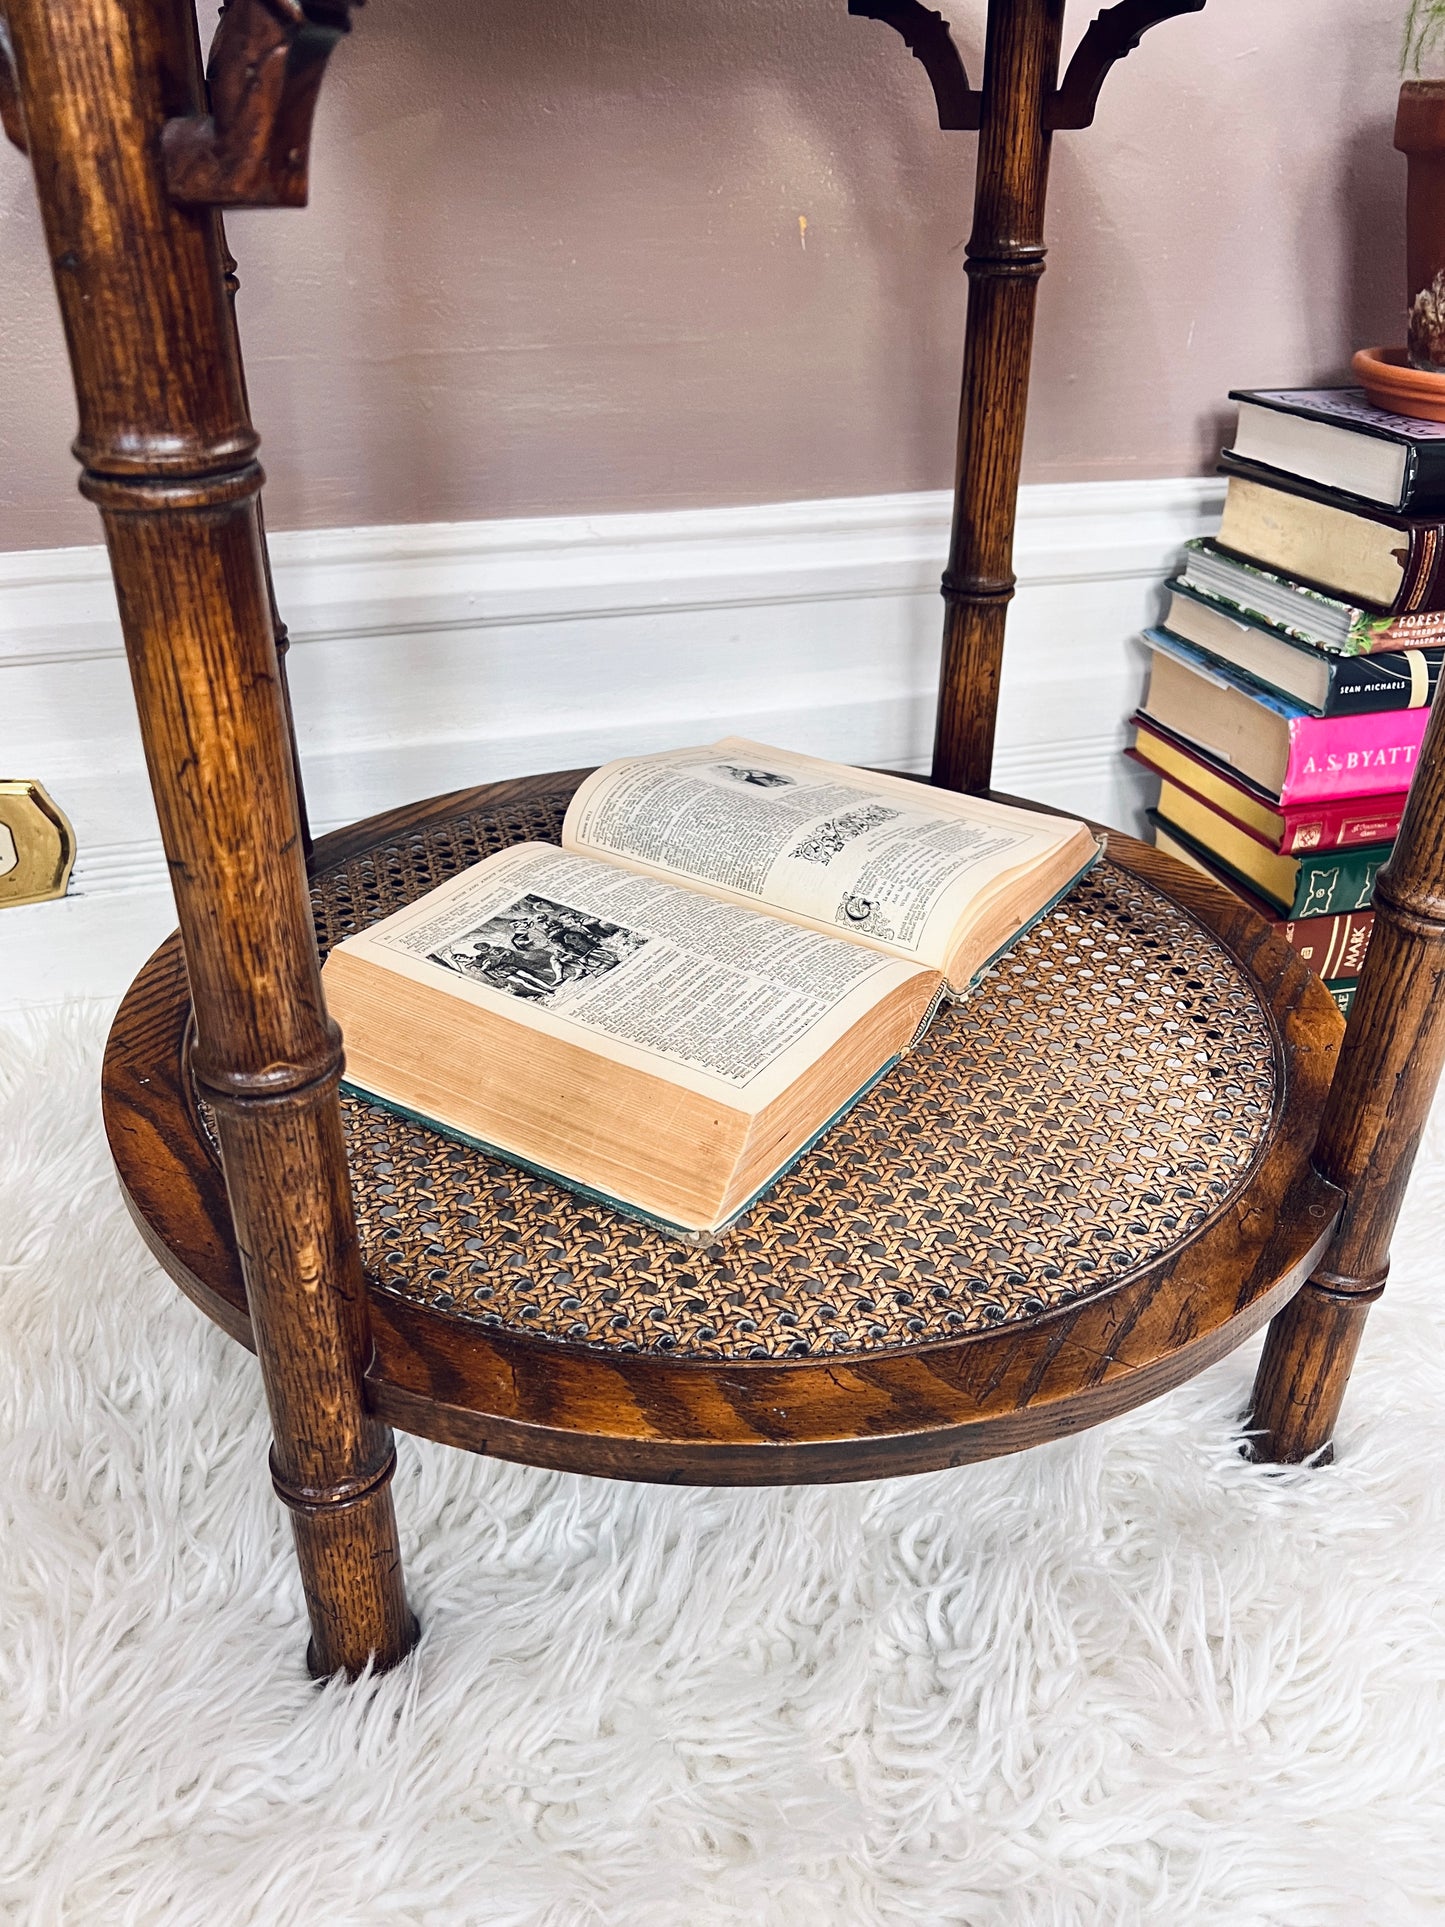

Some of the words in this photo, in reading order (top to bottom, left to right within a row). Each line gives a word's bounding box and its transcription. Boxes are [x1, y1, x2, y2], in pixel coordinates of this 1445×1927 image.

[1340, 685, 1361, 694] SEAN
[1364, 681, 1405, 692] MICHAELS
[1347, 745, 1417, 769] BYATT
[1343, 926, 1366, 967] MARK
